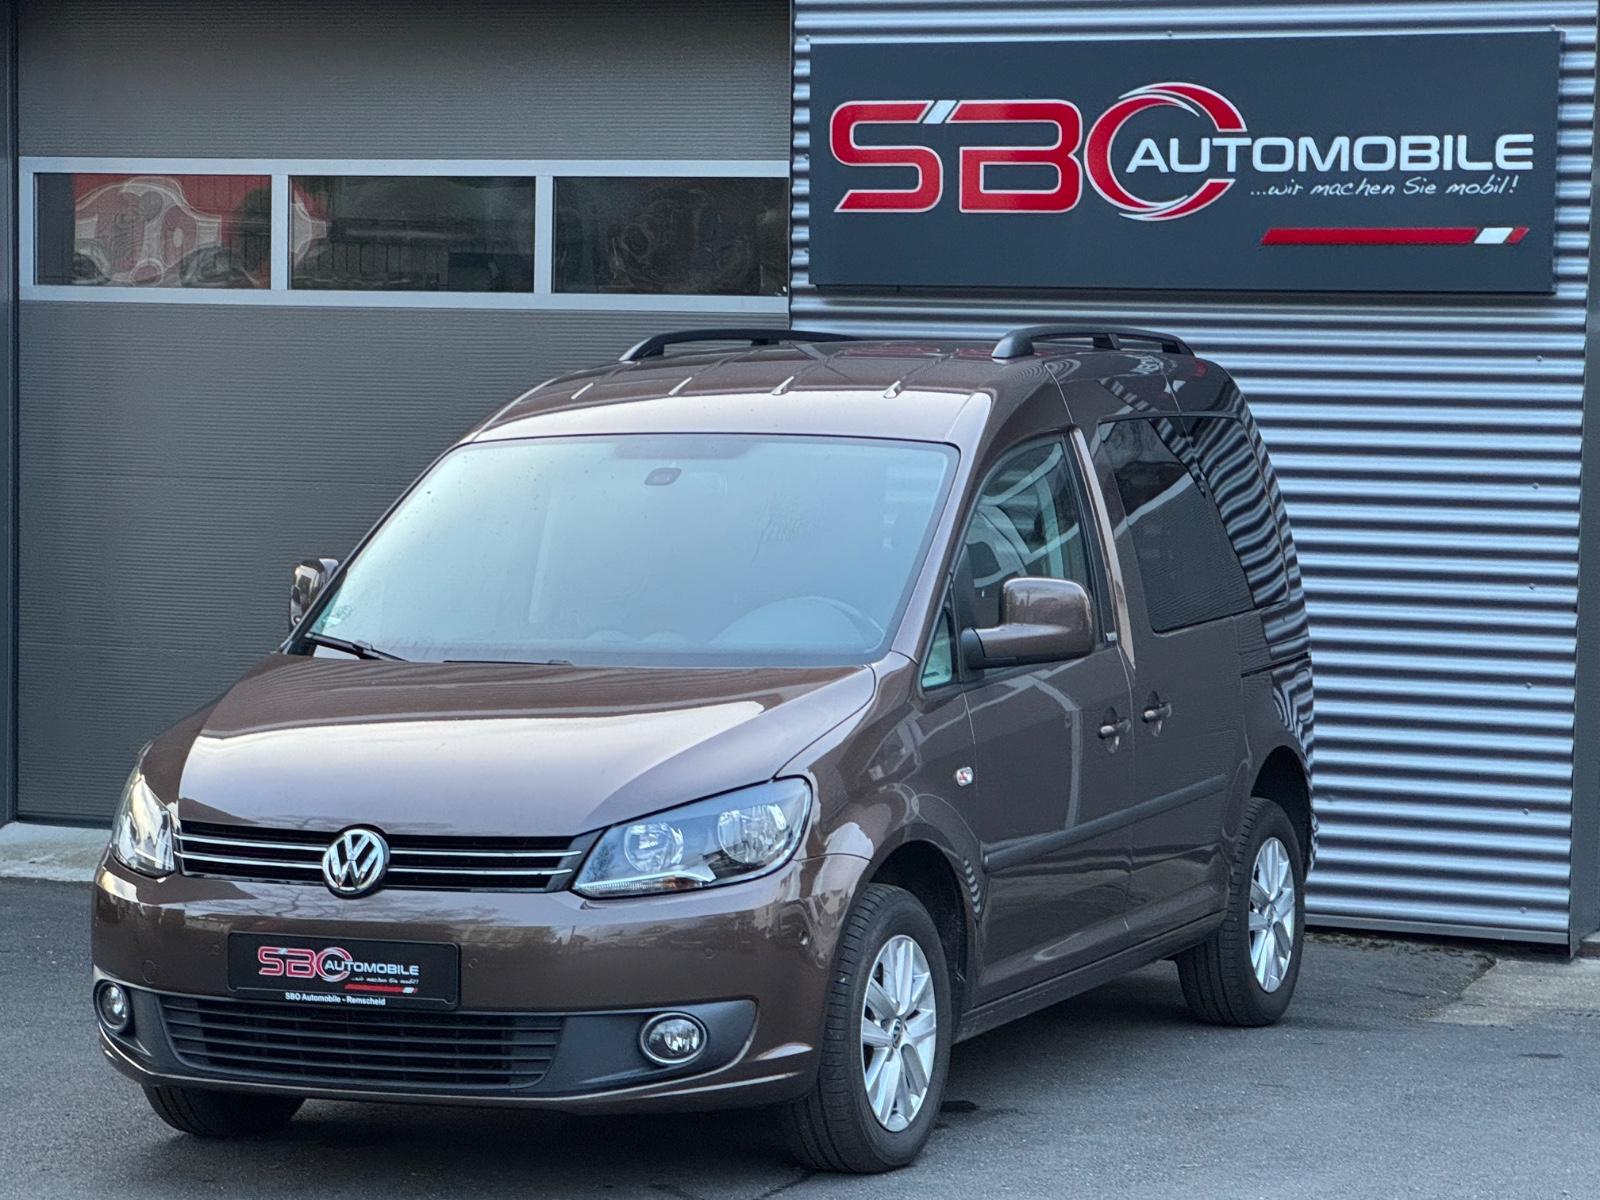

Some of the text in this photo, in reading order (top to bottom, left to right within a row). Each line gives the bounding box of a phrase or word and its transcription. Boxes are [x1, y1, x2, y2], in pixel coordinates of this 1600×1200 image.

[1125, 133, 1534, 173] AUTOMOBILE
[1310, 178, 1396, 197] machen
[1403, 176, 1437, 195] Sie
[1446, 174, 1519, 195] mobil!
[324, 959, 419, 976] AUTOMOBILE
[285, 992, 301, 1001] SBO
[302, 993, 341, 1003] Automobile
[346, 996, 386, 1006] Remscheid
